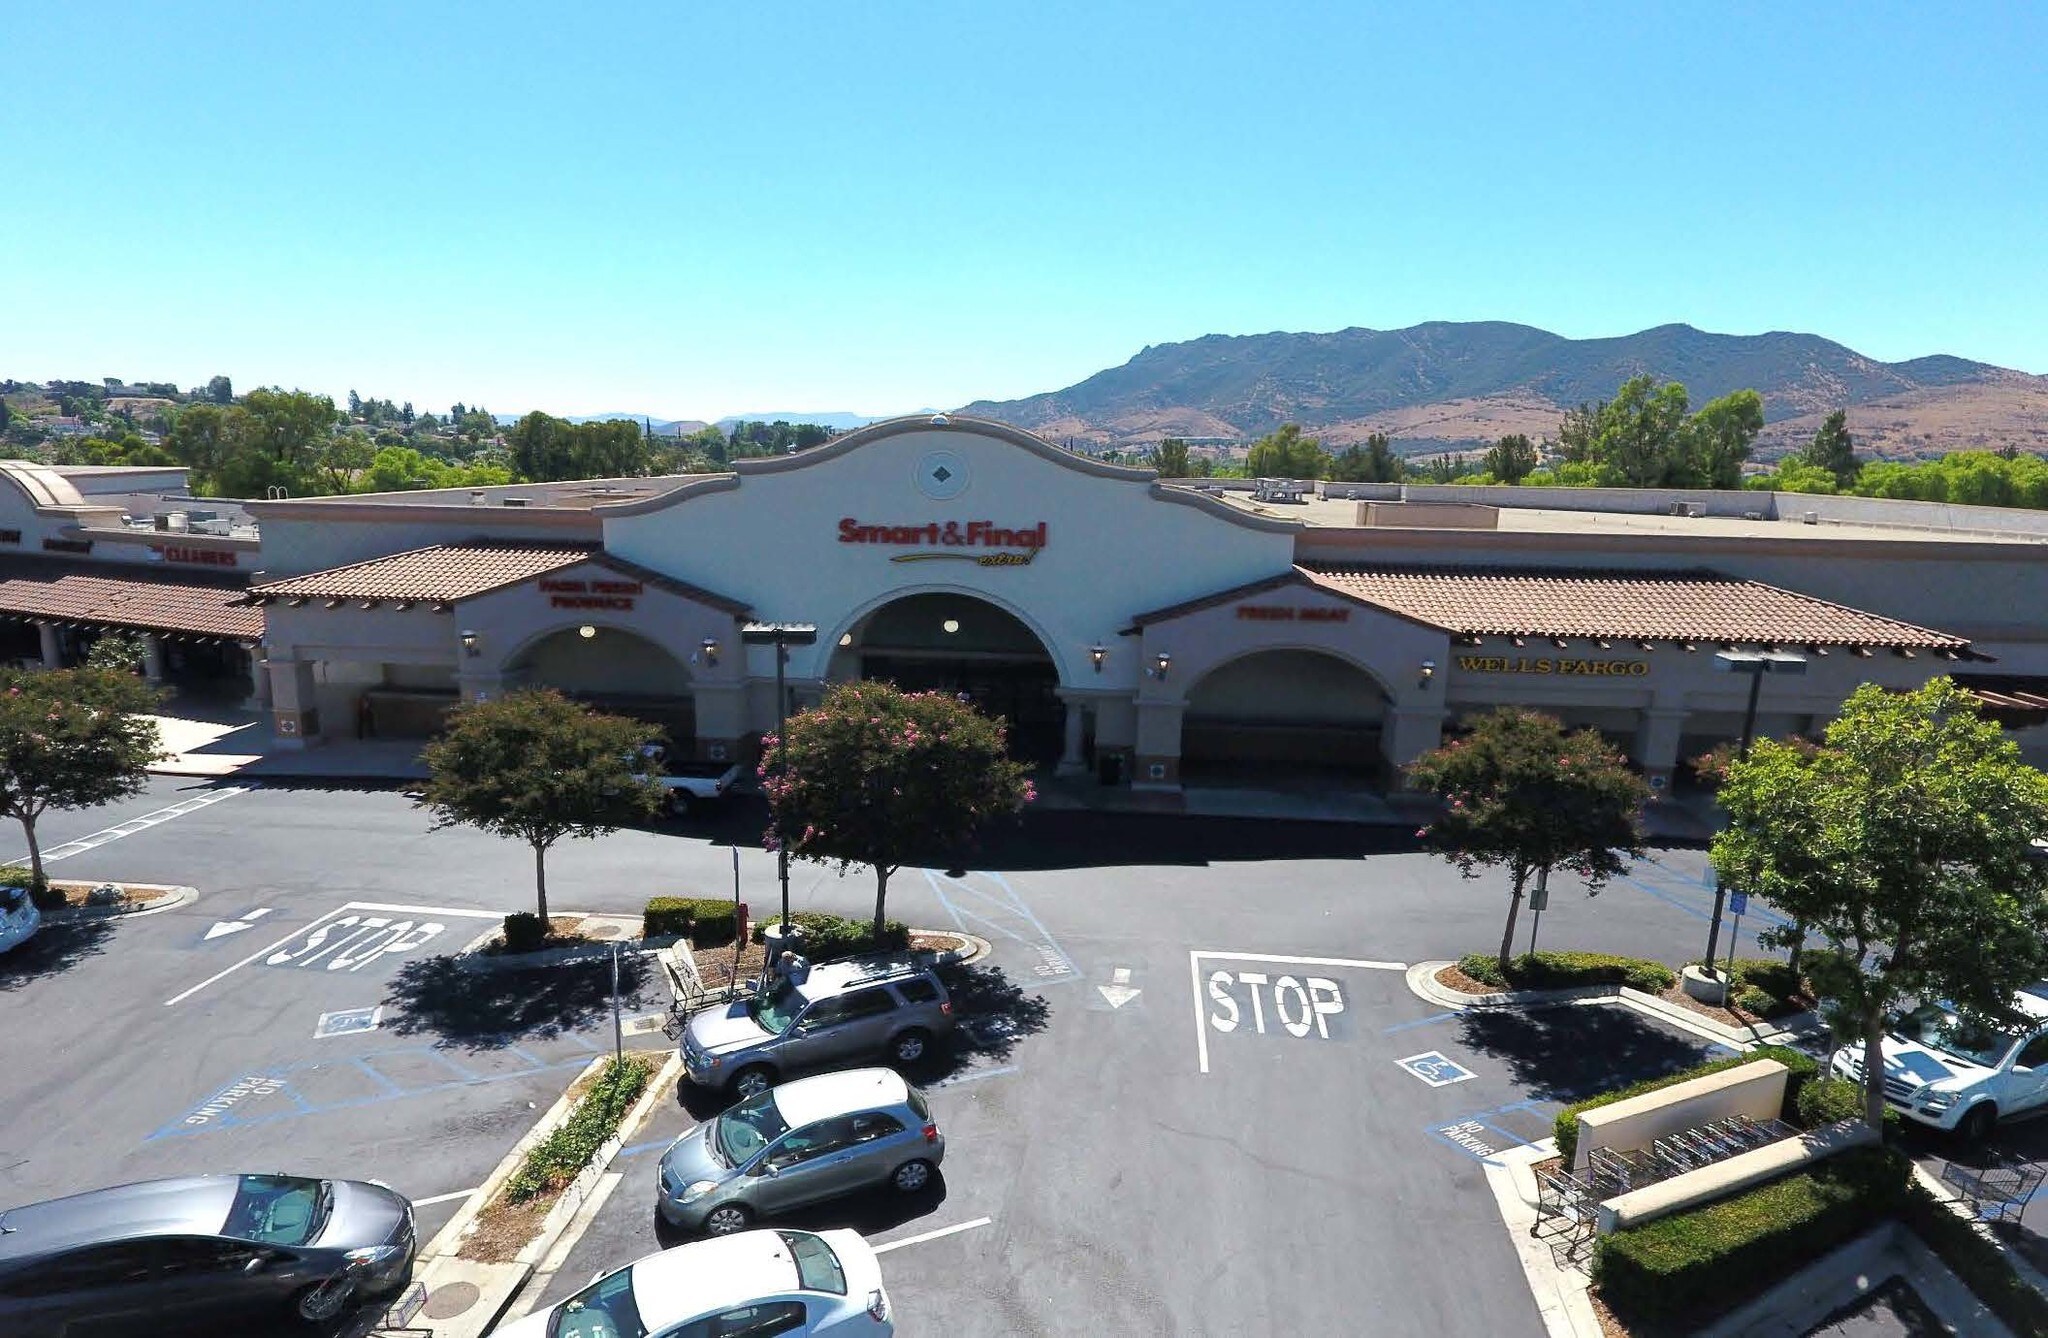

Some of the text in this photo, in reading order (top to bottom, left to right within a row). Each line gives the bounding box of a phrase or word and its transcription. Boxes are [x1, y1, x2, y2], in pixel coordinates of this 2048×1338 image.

[165, 544, 237, 567] CLEANERS
[1458, 656, 1648, 676] WELLS FARGO
[266, 915, 446, 972] STOP
[1208, 970, 1344, 1039] STOP
[185, 1077, 267, 1124] PARKING
[253, 1079, 287, 1095] NO
[1458, 1120, 1485, 1133] NO
[1439, 1125, 1495, 1157] PARKING
